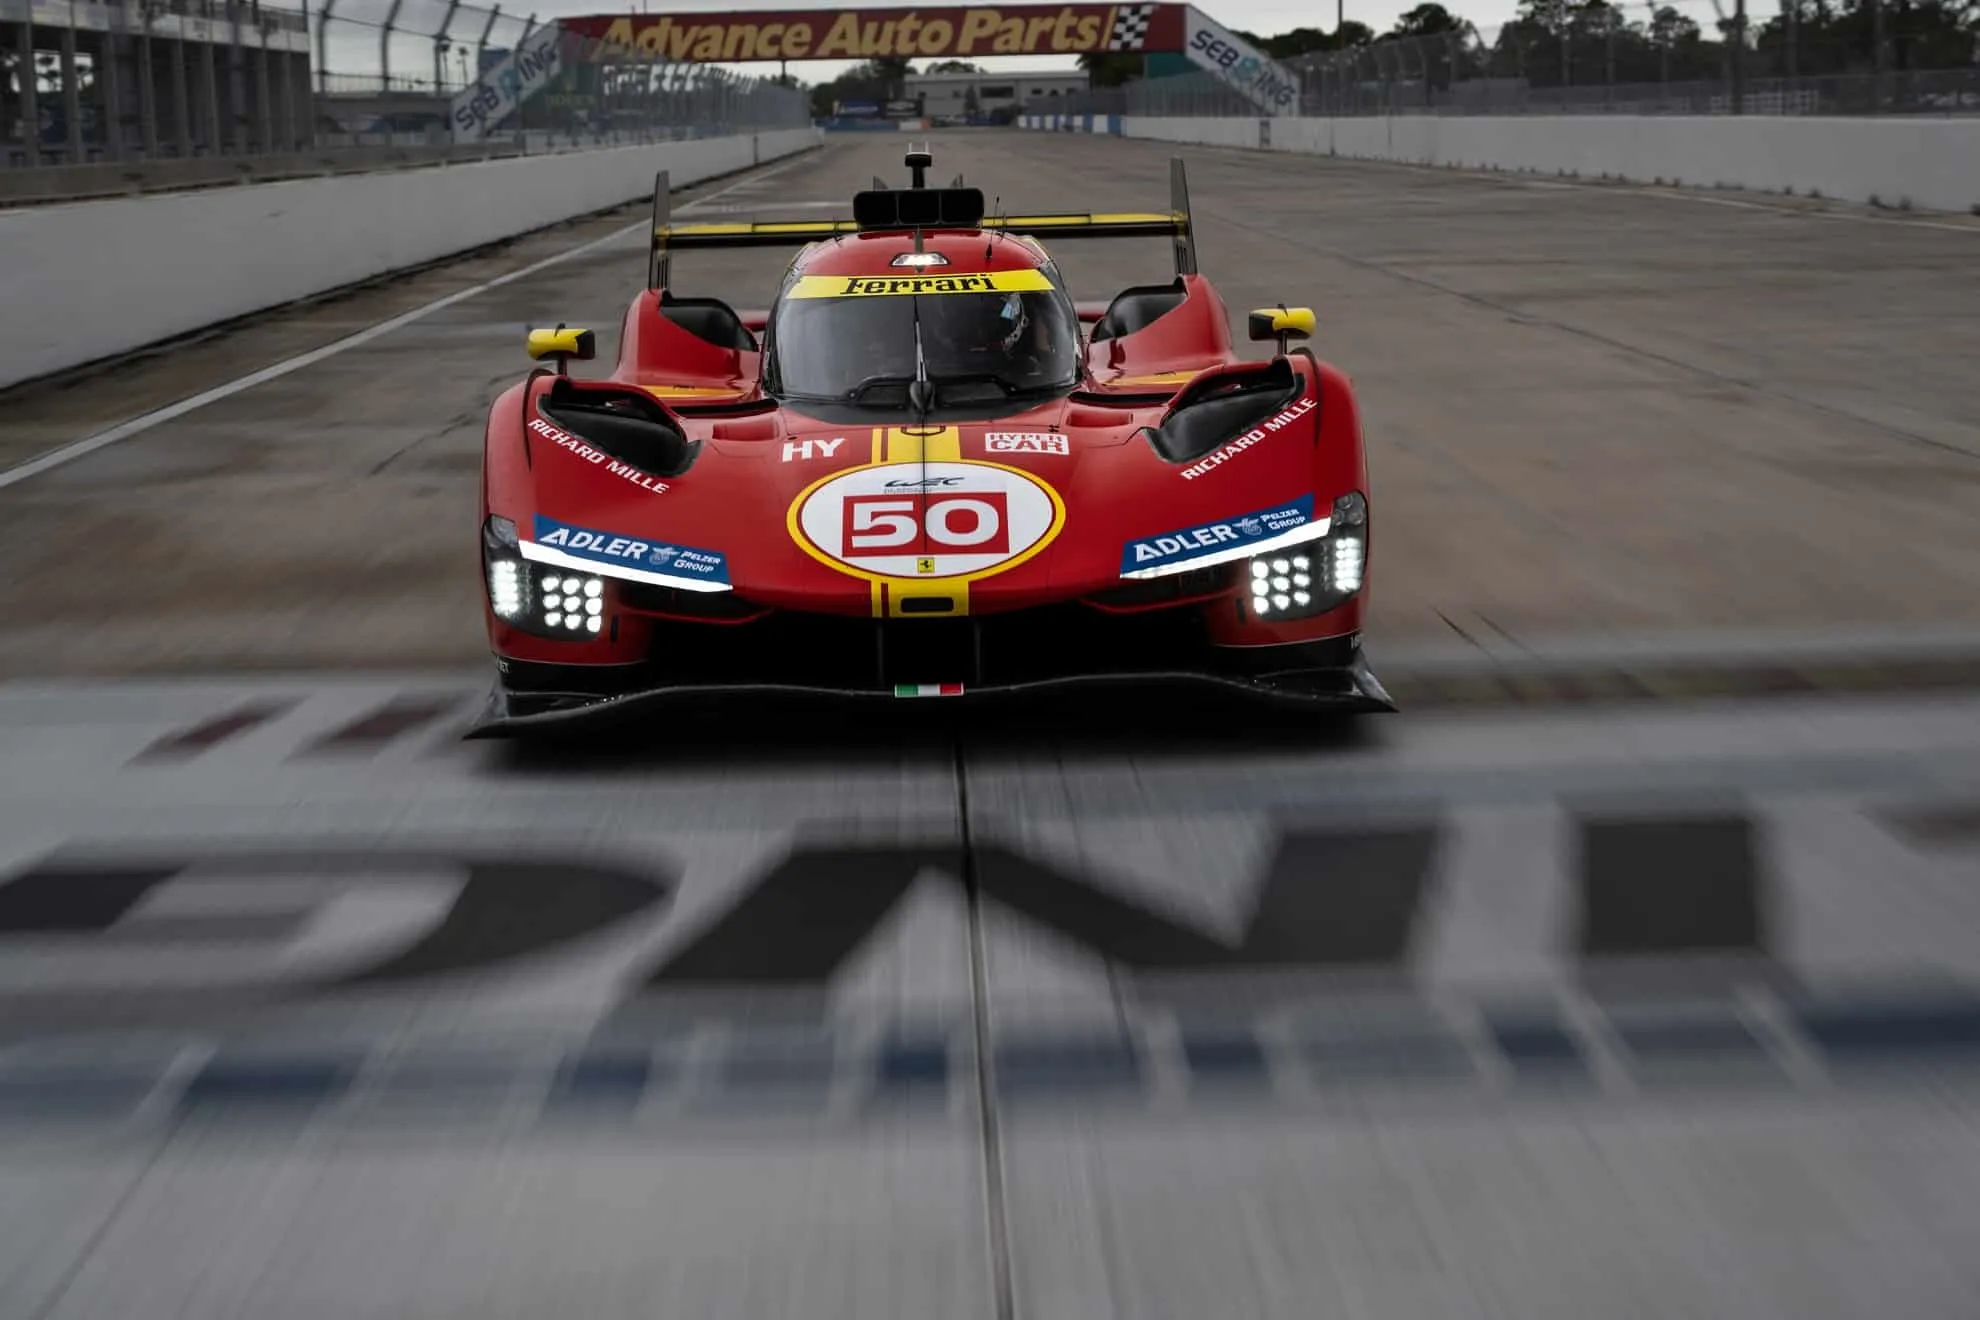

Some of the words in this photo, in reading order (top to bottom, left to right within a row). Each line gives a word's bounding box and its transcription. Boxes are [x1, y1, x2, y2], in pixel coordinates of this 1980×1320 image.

[590, 16, 813, 61] Advance
[815, 12, 954, 58] Auto
[957, 7, 1102, 54] Parts
[455, 41, 557, 131] SEBRING
[1189, 29, 1297, 107] SEBRING
[839, 273, 998, 295] Ferrari
[528, 418, 606, 465] RICHARD
[605, 460, 670, 494] MILLE
[781, 438, 845, 462] HY
[989, 433, 1063, 442] HYPER
[989, 440, 1064, 452] CAR
[1180, 429, 1266, 480] RICHARD
[1265, 398, 1318, 432] MILLE
[884, 476, 965, 488] WEC
[851, 499, 999, 549] 50
[1133, 524, 1240, 562] ADLER
[539, 527, 649, 560] ADLER
